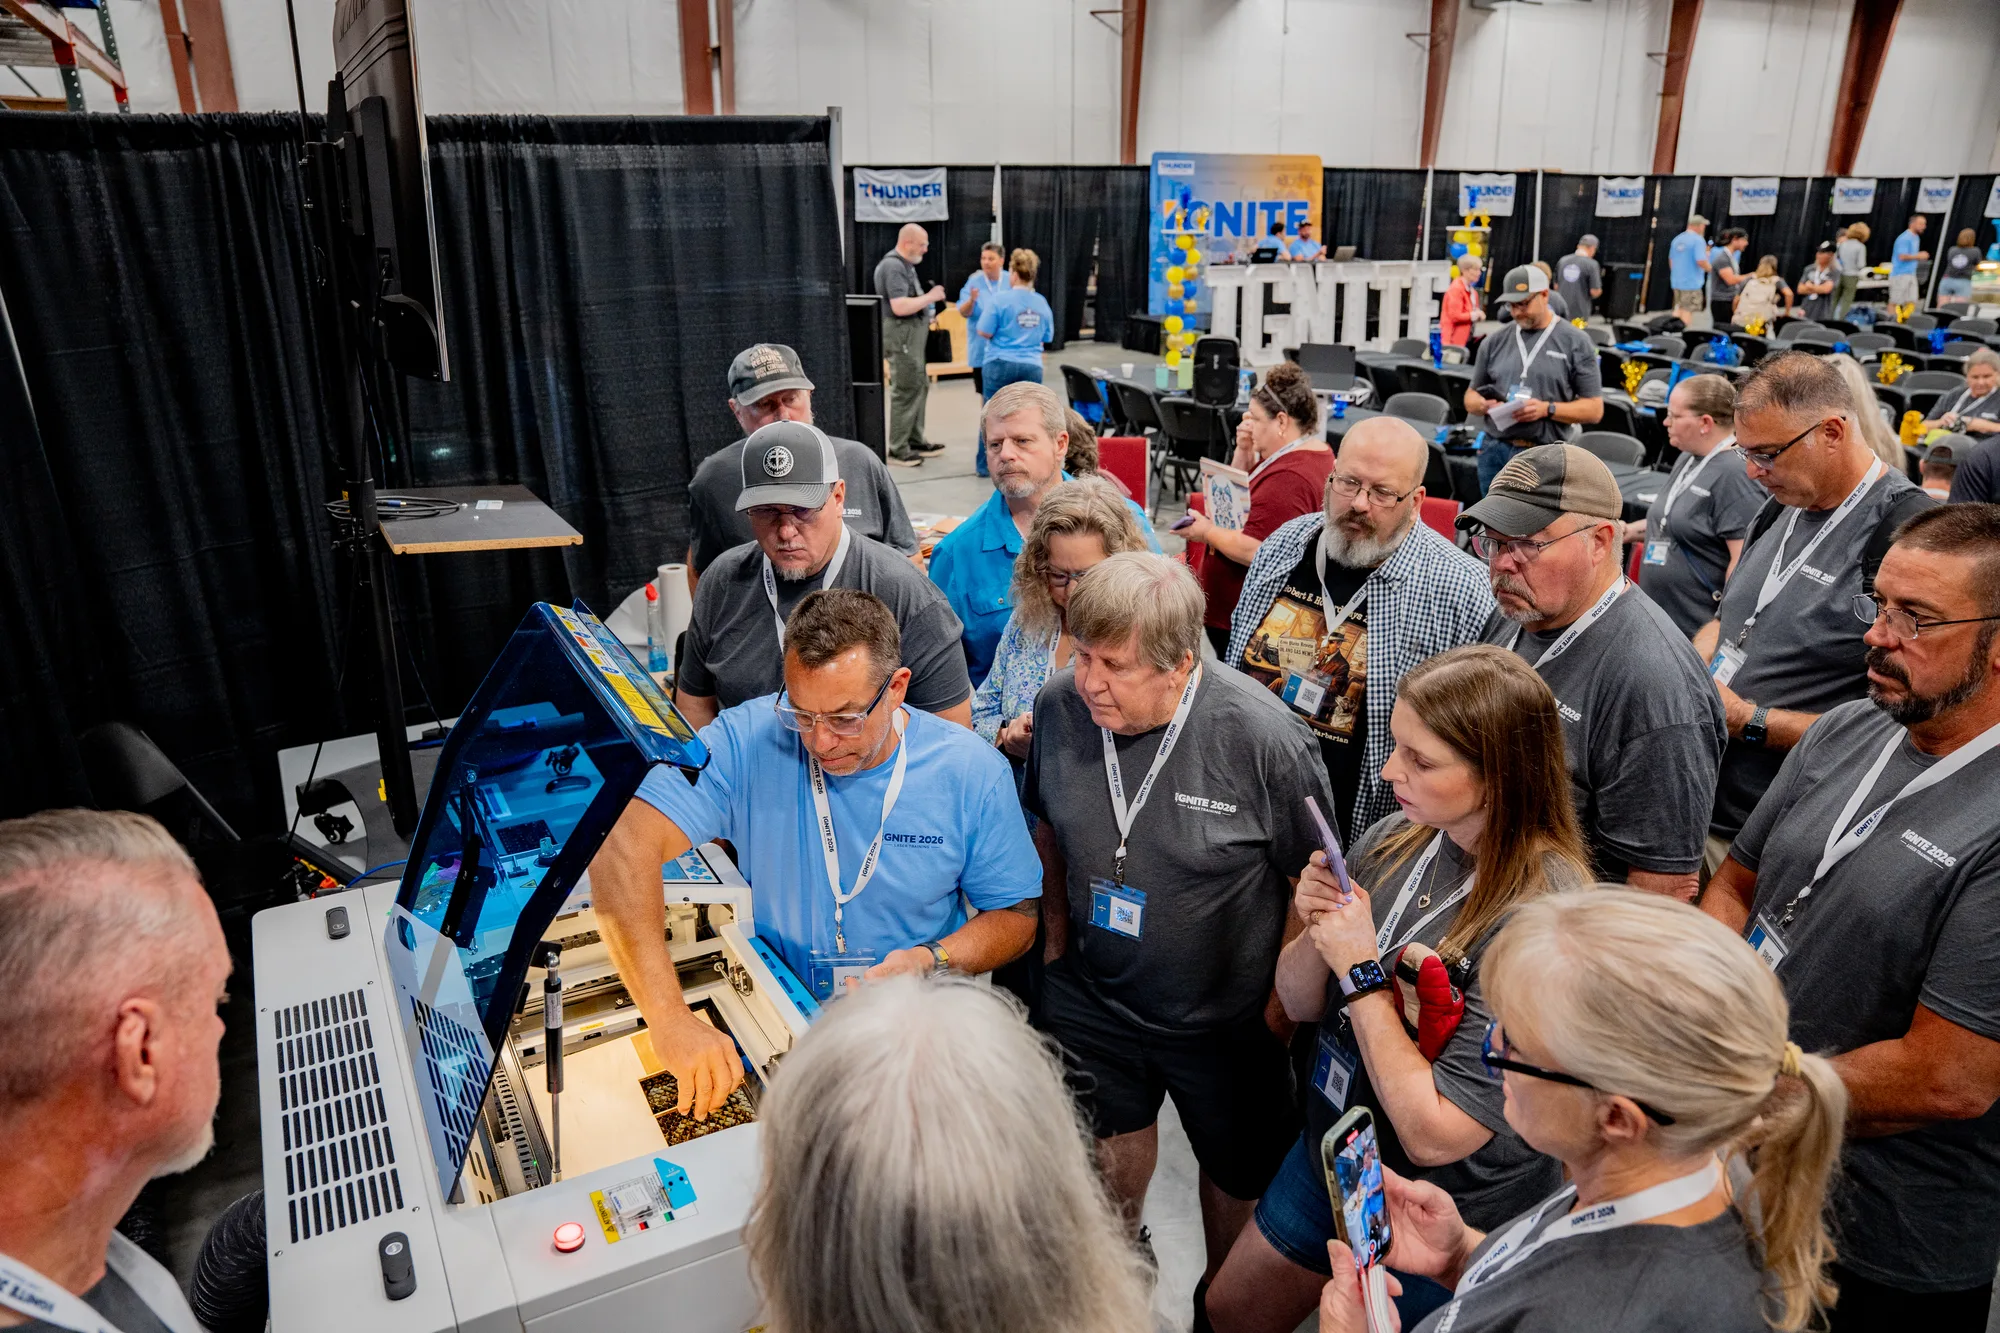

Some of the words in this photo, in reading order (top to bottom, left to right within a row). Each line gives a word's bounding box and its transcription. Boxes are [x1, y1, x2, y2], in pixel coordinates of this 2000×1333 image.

[859, 182, 942, 199] THUNDER
[1163, 199, 1309, 238] IGNITE
[1508, 481, 1531, 492] Kubota
[1603, 590, 1617, 605] IGNITE
[1591, 605, 1604, 618] 2026
[1563, 630, 1578, 645] IGNITE
[1551, 644, 1564, 656] 2026
[1182, 686, 1192, 705] IGNITE
[1560, 704, 1582, 721] 2026
[1159, 737, 1172, 756] IGNITE
[1168, 723, 1177, 738] 2026
[1313, 728, 1349, 744] Barbarian
[813, 758, 821, 778] IGNITE
[1111, 763, 1119, 783] IGNITE
[816, 777, 824, 794] 2026
[1114, 783, 1122, 798] 2026
[1136, 786, 1148, 804] IGNITE
[1145, 773, 1154, 786] 2026
[1175, 792, 1210, 807] IGNITE
[1210, 800, 1237, 813] 2026
[822, 816, 831, 837] IGNITE
[1854, 818, 1873, 837] IGNITE
[826, 836, 834, 853] 2026
[918, 835, 944, 845] 2026
[1901, 829, 1932, 851] IGNITE
[1927, 845, 1957, 867] 2026
[861, 856, 873, 877] IGNITE
[868, 842, 878, 857] 2026
[1418, 856, 1431, 877] IGNITE
[1408, 877, 1419, 892] 2026
[1387, 911, 1399, 932] IGNITE
[1378, 931, 1389, 949] 2026
[597, 1199, 611, 1226] ATTENTION
[1571, 1209, 1596, 1226] IGNITE
